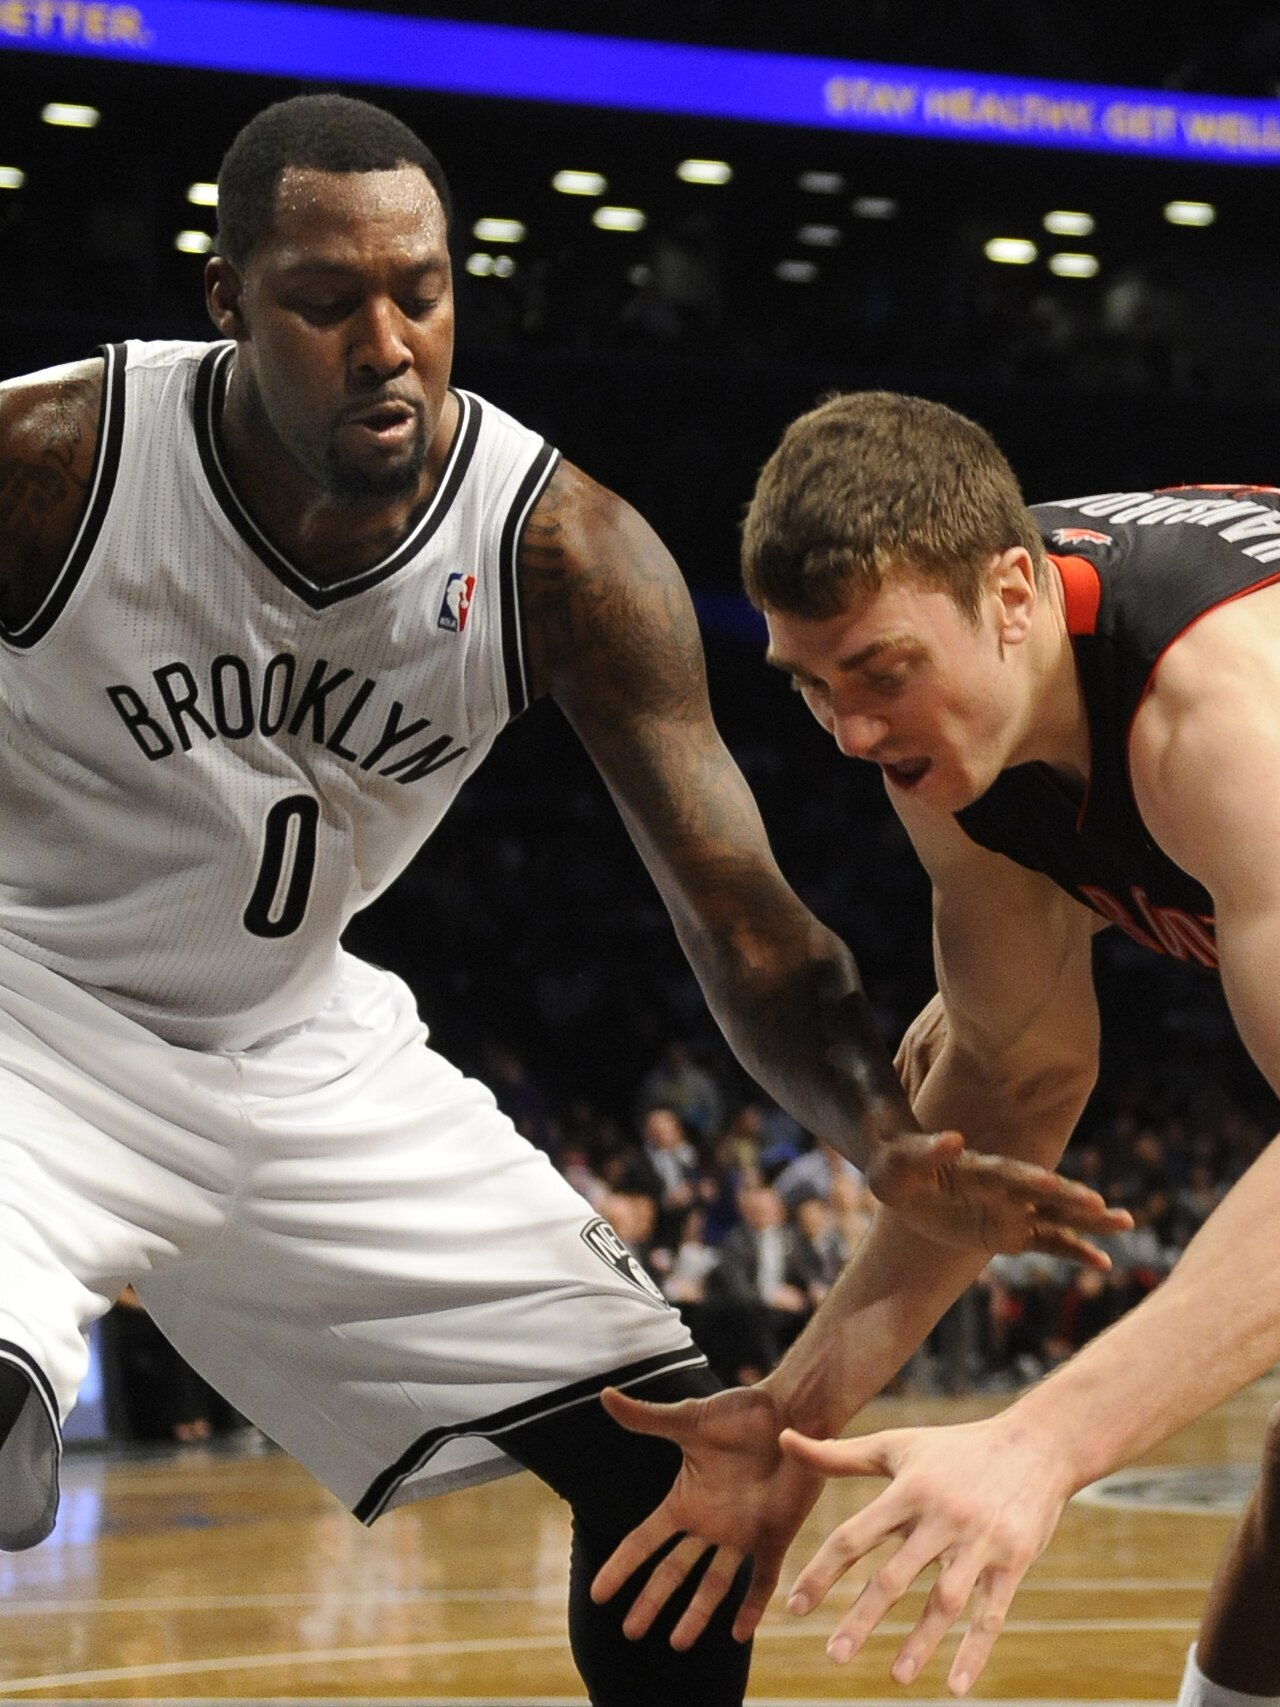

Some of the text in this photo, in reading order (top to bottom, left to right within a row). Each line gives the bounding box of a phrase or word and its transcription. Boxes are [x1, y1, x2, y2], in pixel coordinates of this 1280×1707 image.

[823, 76, 917, 118] STAY
[1103, 101, 1176, 143] GET
[106, 653, 468, 785] BROOKLYN
[243, 794, 319, 938] 0
